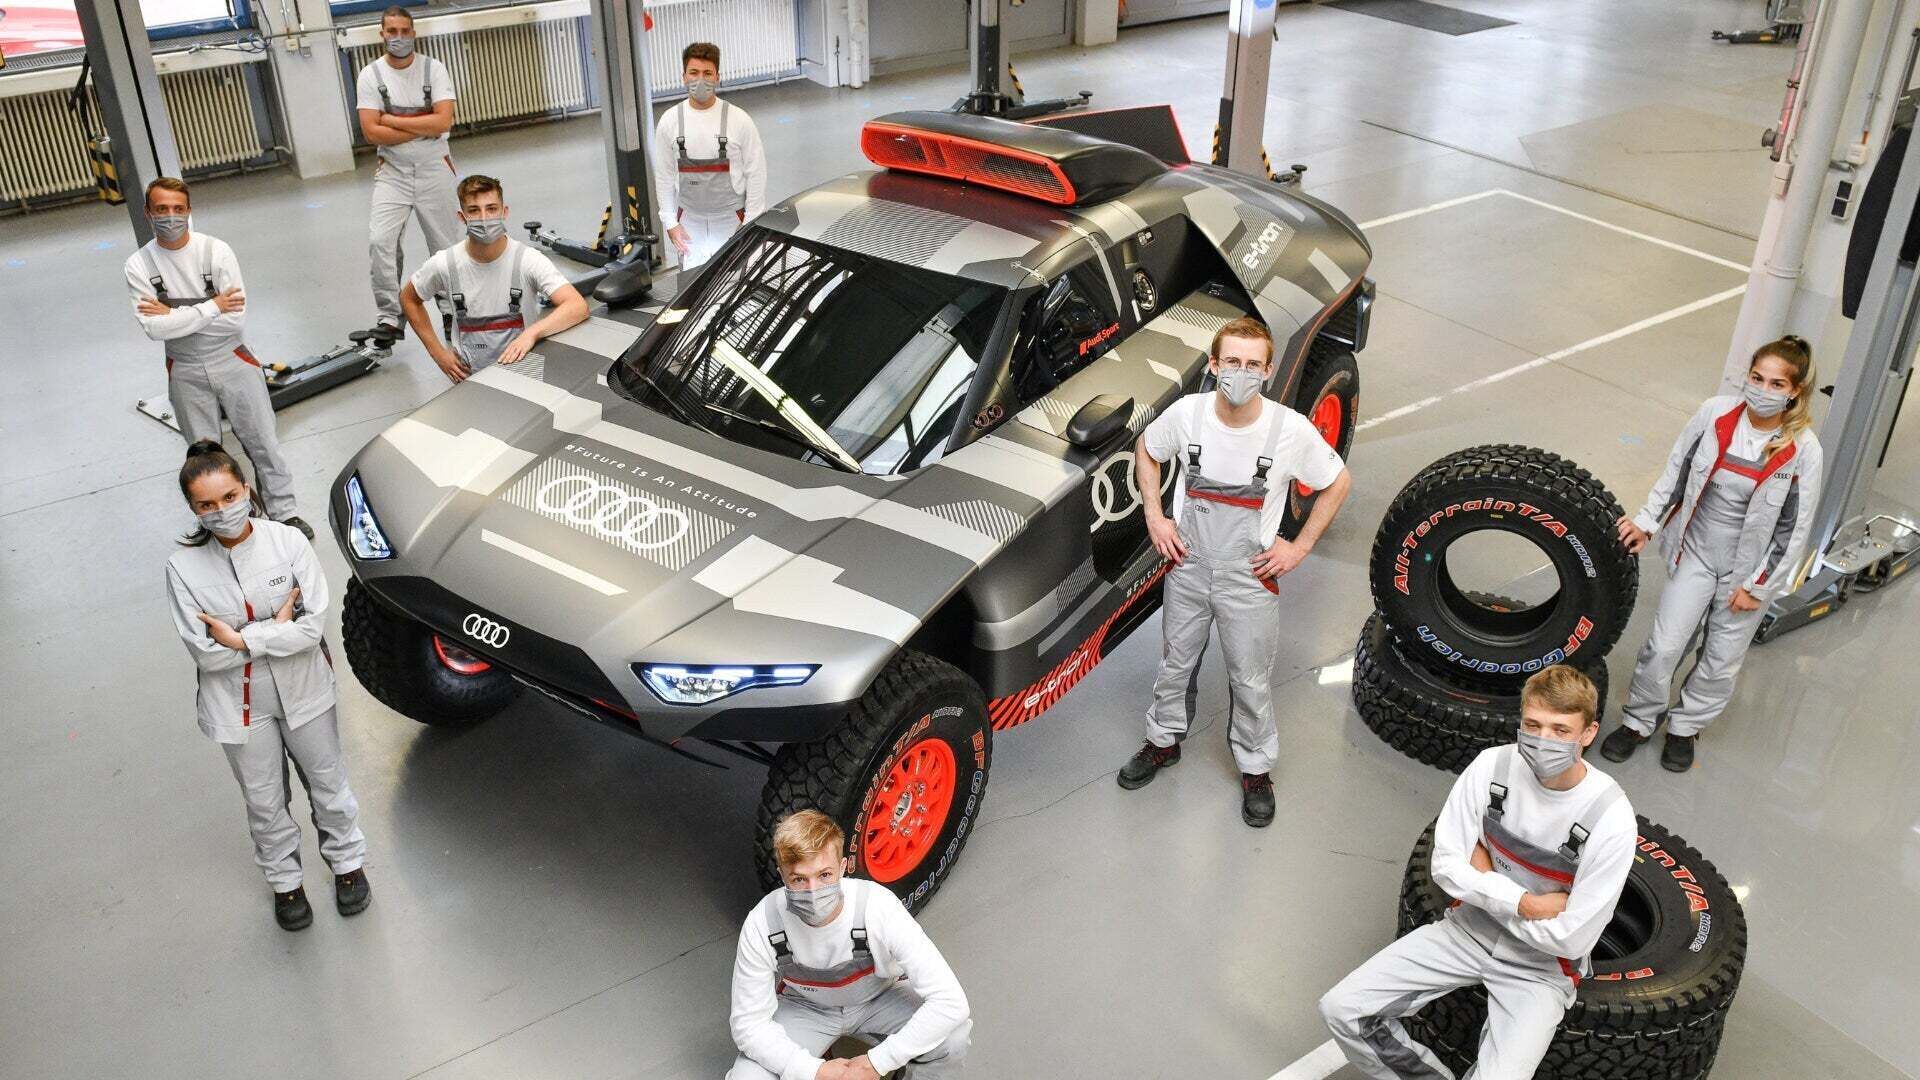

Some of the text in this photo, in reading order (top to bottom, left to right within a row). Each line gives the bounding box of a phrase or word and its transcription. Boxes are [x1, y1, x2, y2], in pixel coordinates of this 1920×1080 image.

[1243, 222, 1283, 269] e-tron
[564, 444, 758, 519] #Future Is An Attitude
[1416, 616, 1594, 673] BFGoodrich
[1024, 649, 1089, 709] e-tron
